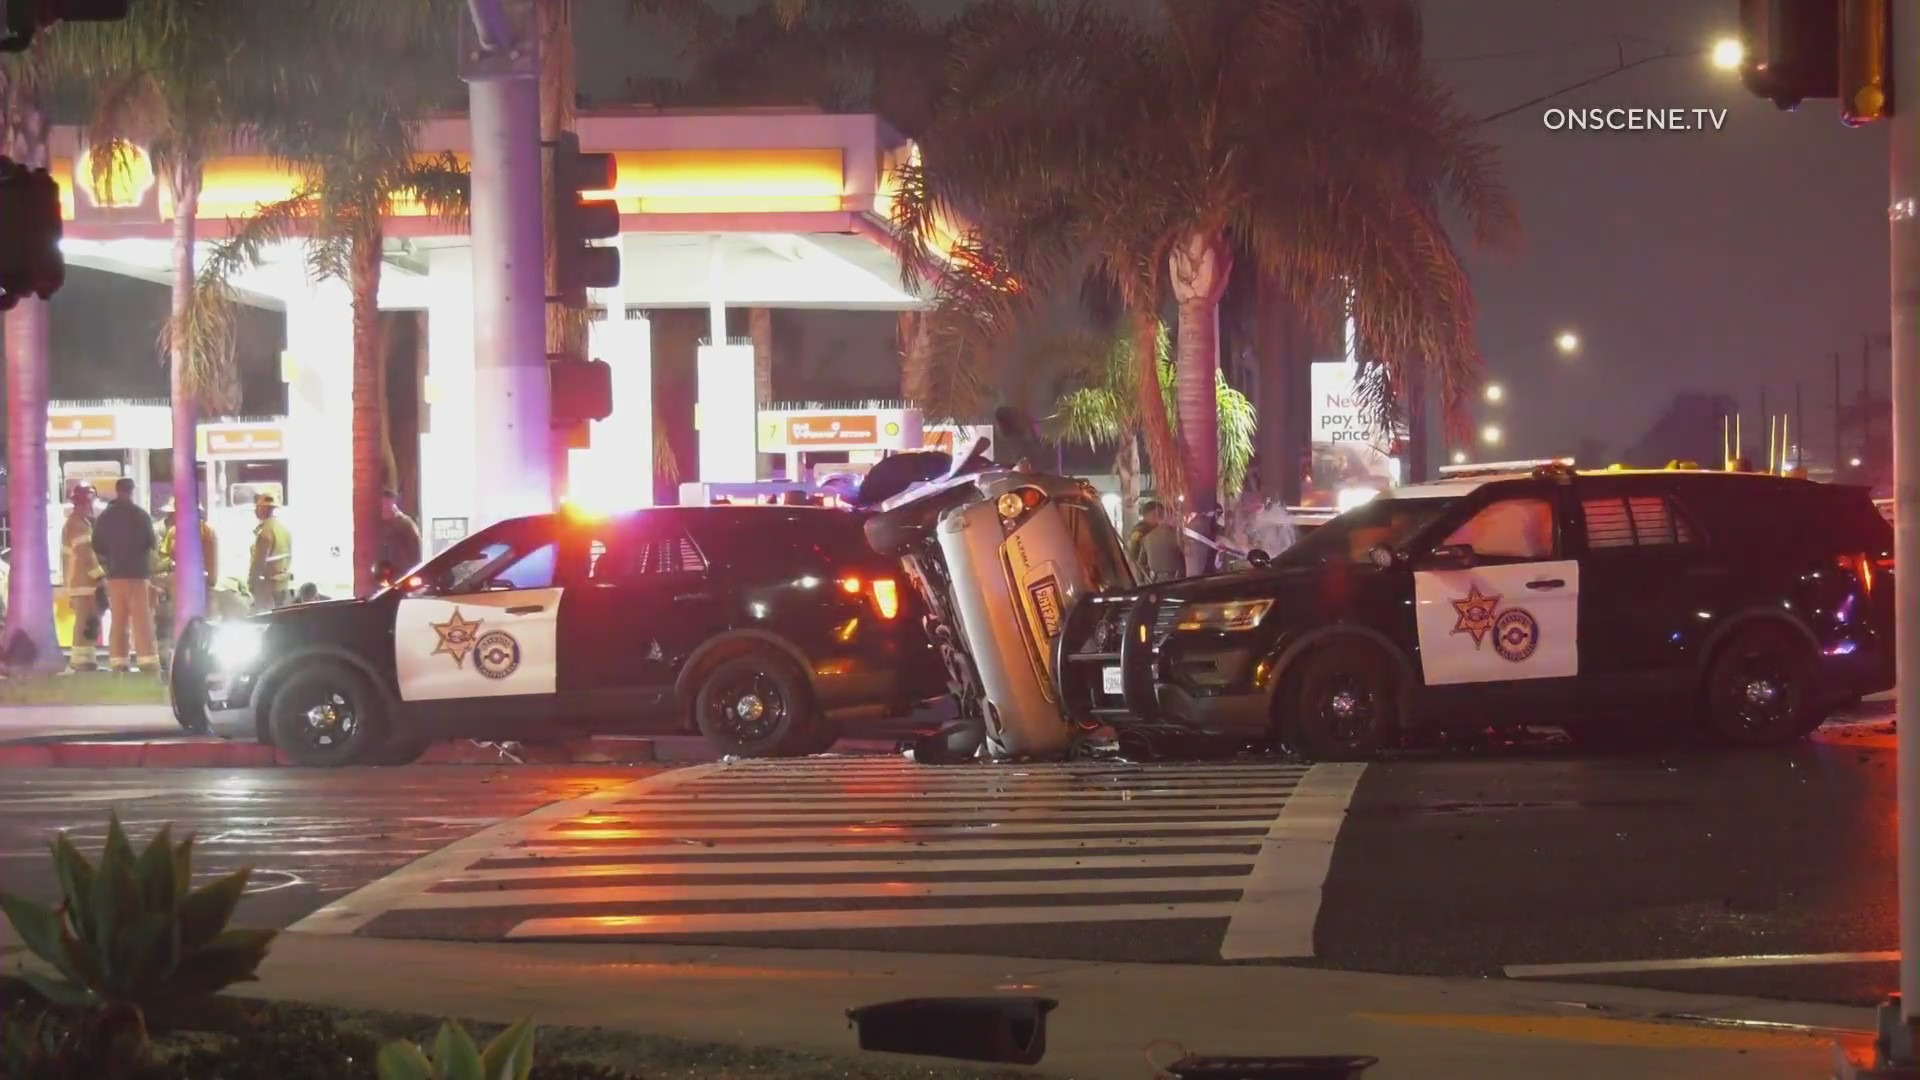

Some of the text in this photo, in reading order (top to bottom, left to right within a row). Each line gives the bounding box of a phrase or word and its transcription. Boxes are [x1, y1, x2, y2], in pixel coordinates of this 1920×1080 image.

[1326, 393, 1370, 408] Nev
[1321, 414, 1353, 429] pay
[769, 424, 778, 439] 7
[1332, 425, 1370, 446] price
